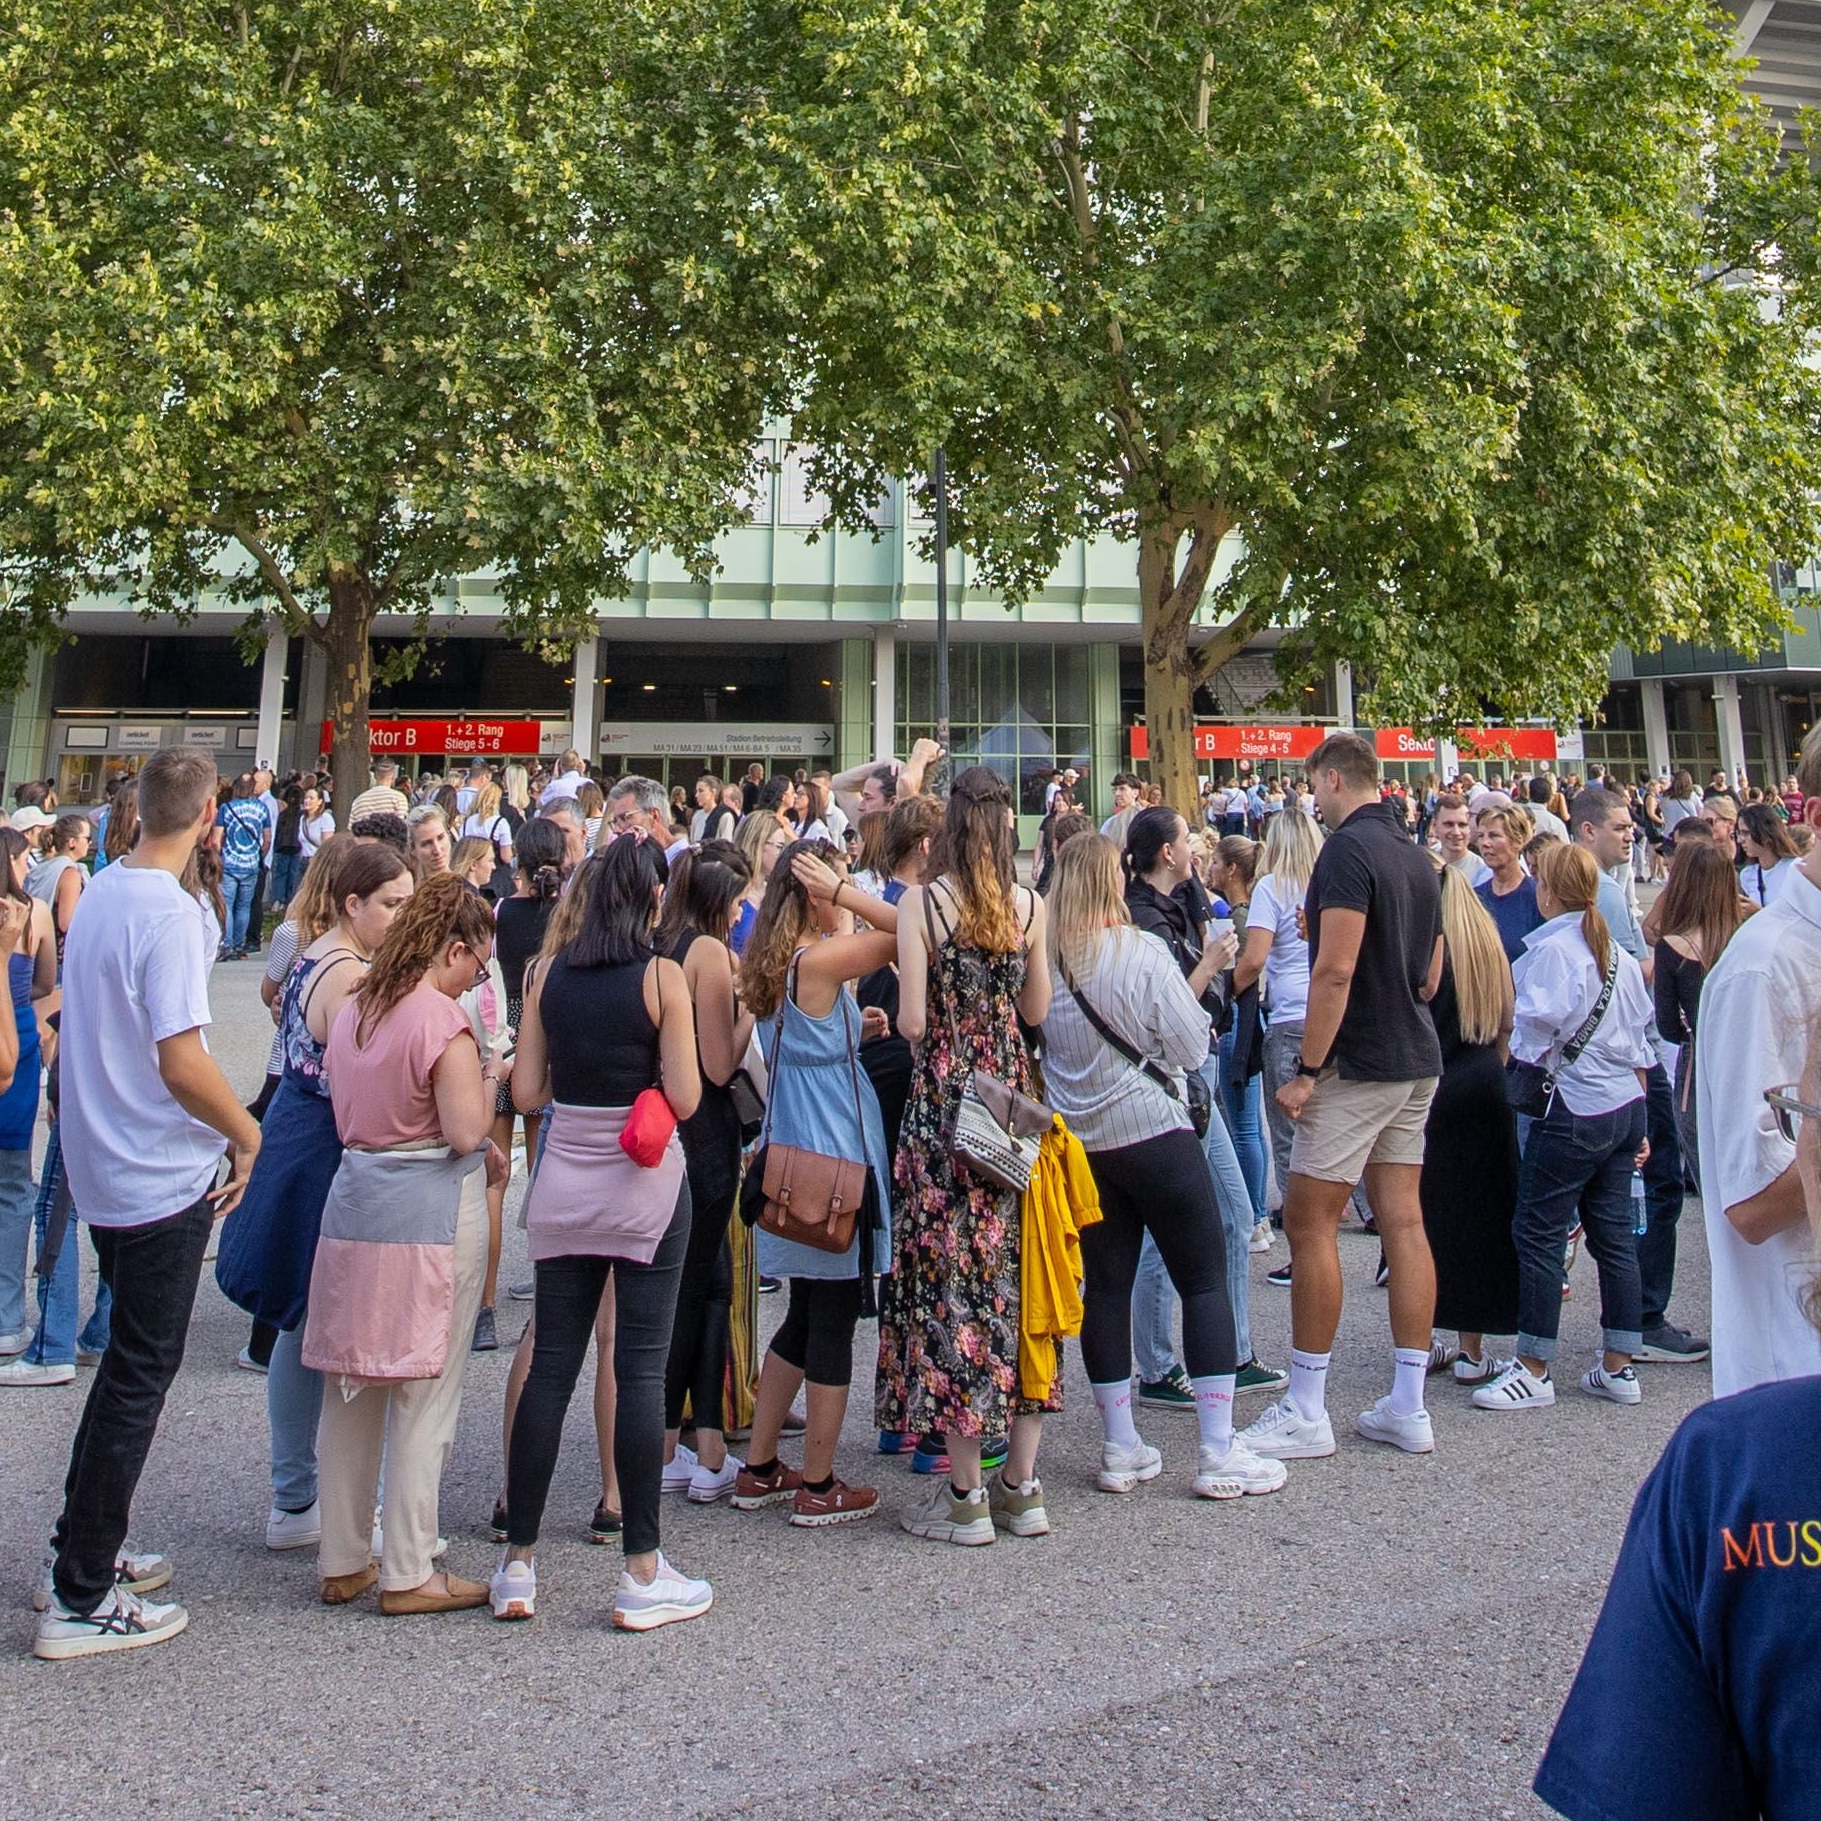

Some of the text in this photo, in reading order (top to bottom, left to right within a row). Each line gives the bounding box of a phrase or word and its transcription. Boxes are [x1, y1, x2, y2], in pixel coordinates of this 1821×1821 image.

[369, 728, 417, 746] ktor B
[478, 724, 504, 738] Rang
[726, 734, 751, 742] Stadion
[1269, 730, 1292, 742] Rang
[444, 737, 476, 751] Stiege
[1205, 734, 1216, 751] B
[1240, 743, 1269, 755] Stiege
[1570, 1014, 1599, 1048] BIMBA
